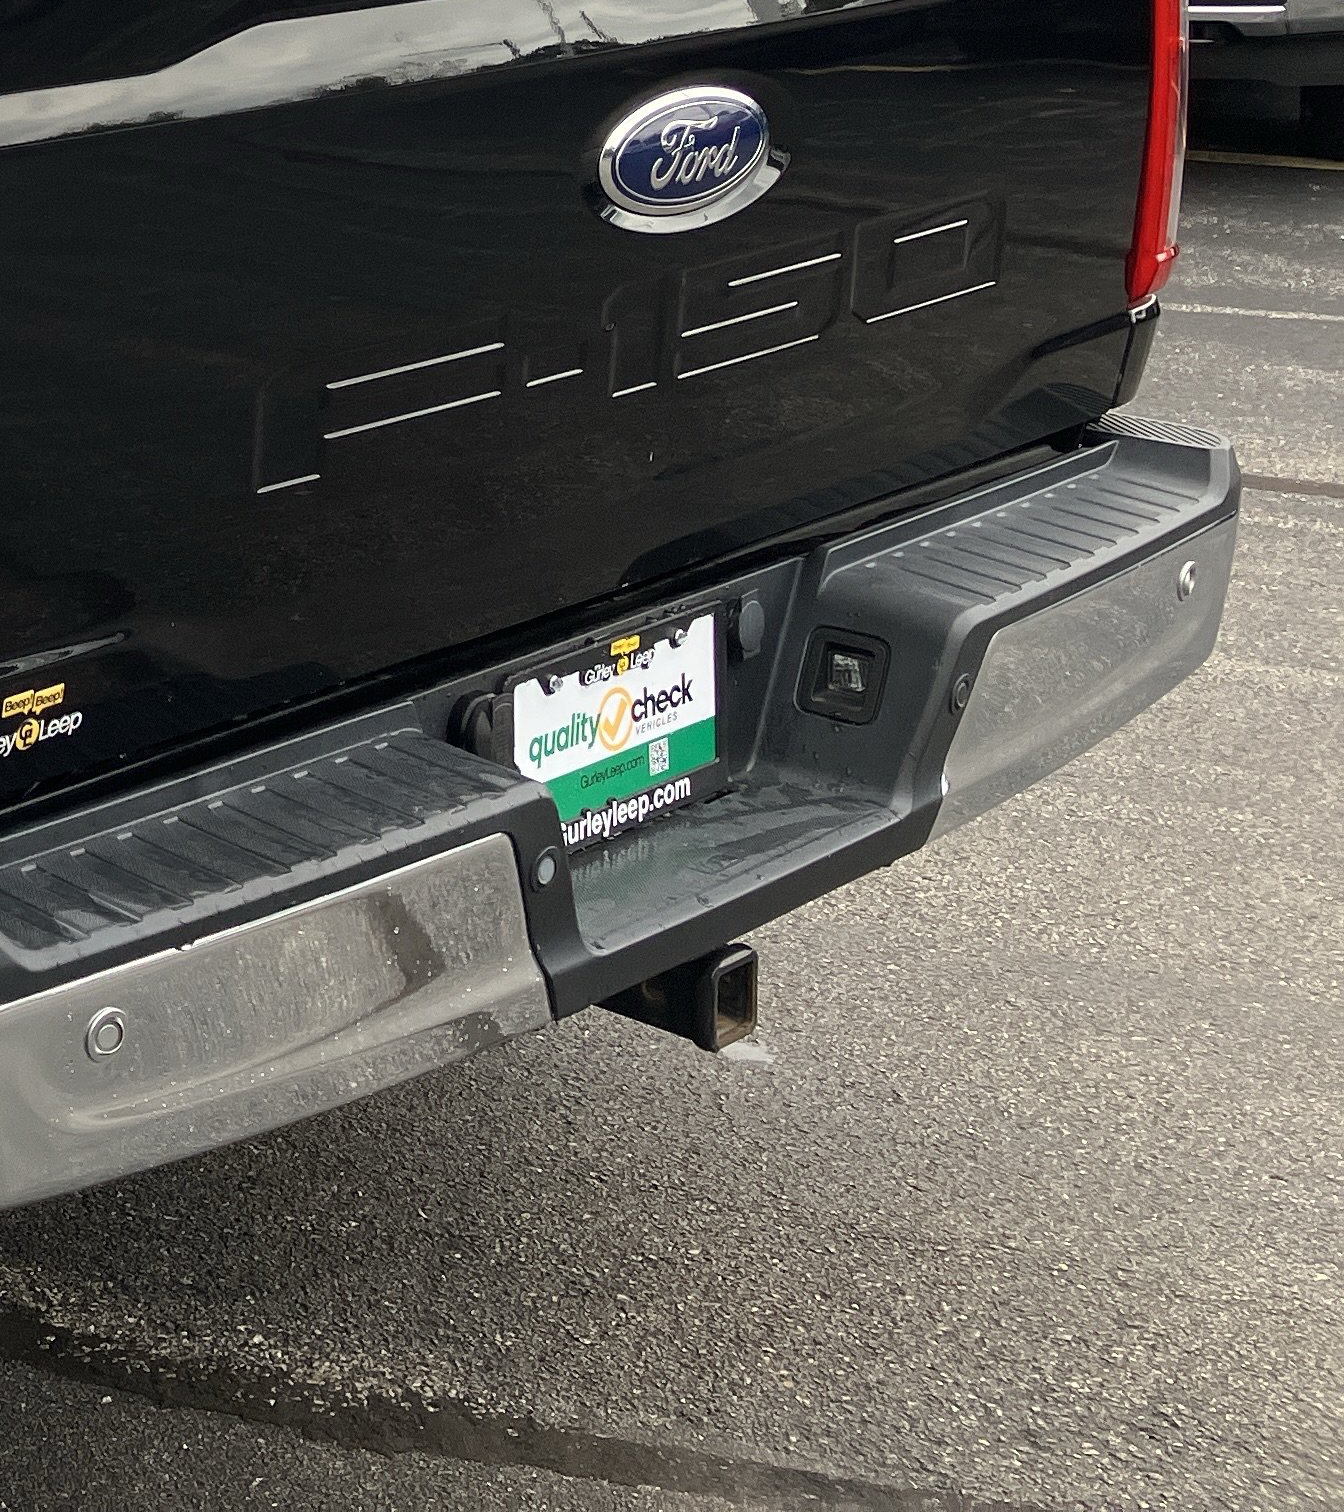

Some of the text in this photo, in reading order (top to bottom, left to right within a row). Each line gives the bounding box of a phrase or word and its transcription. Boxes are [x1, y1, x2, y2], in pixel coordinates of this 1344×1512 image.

[650, 115, 741, 191] Ford
[254, 200, 1004, 493] F-150
[38, 711, 83, 741] Leep
[529, 672, 693, 769] quality check
[635, 710, 678, 735] VEHICLES
